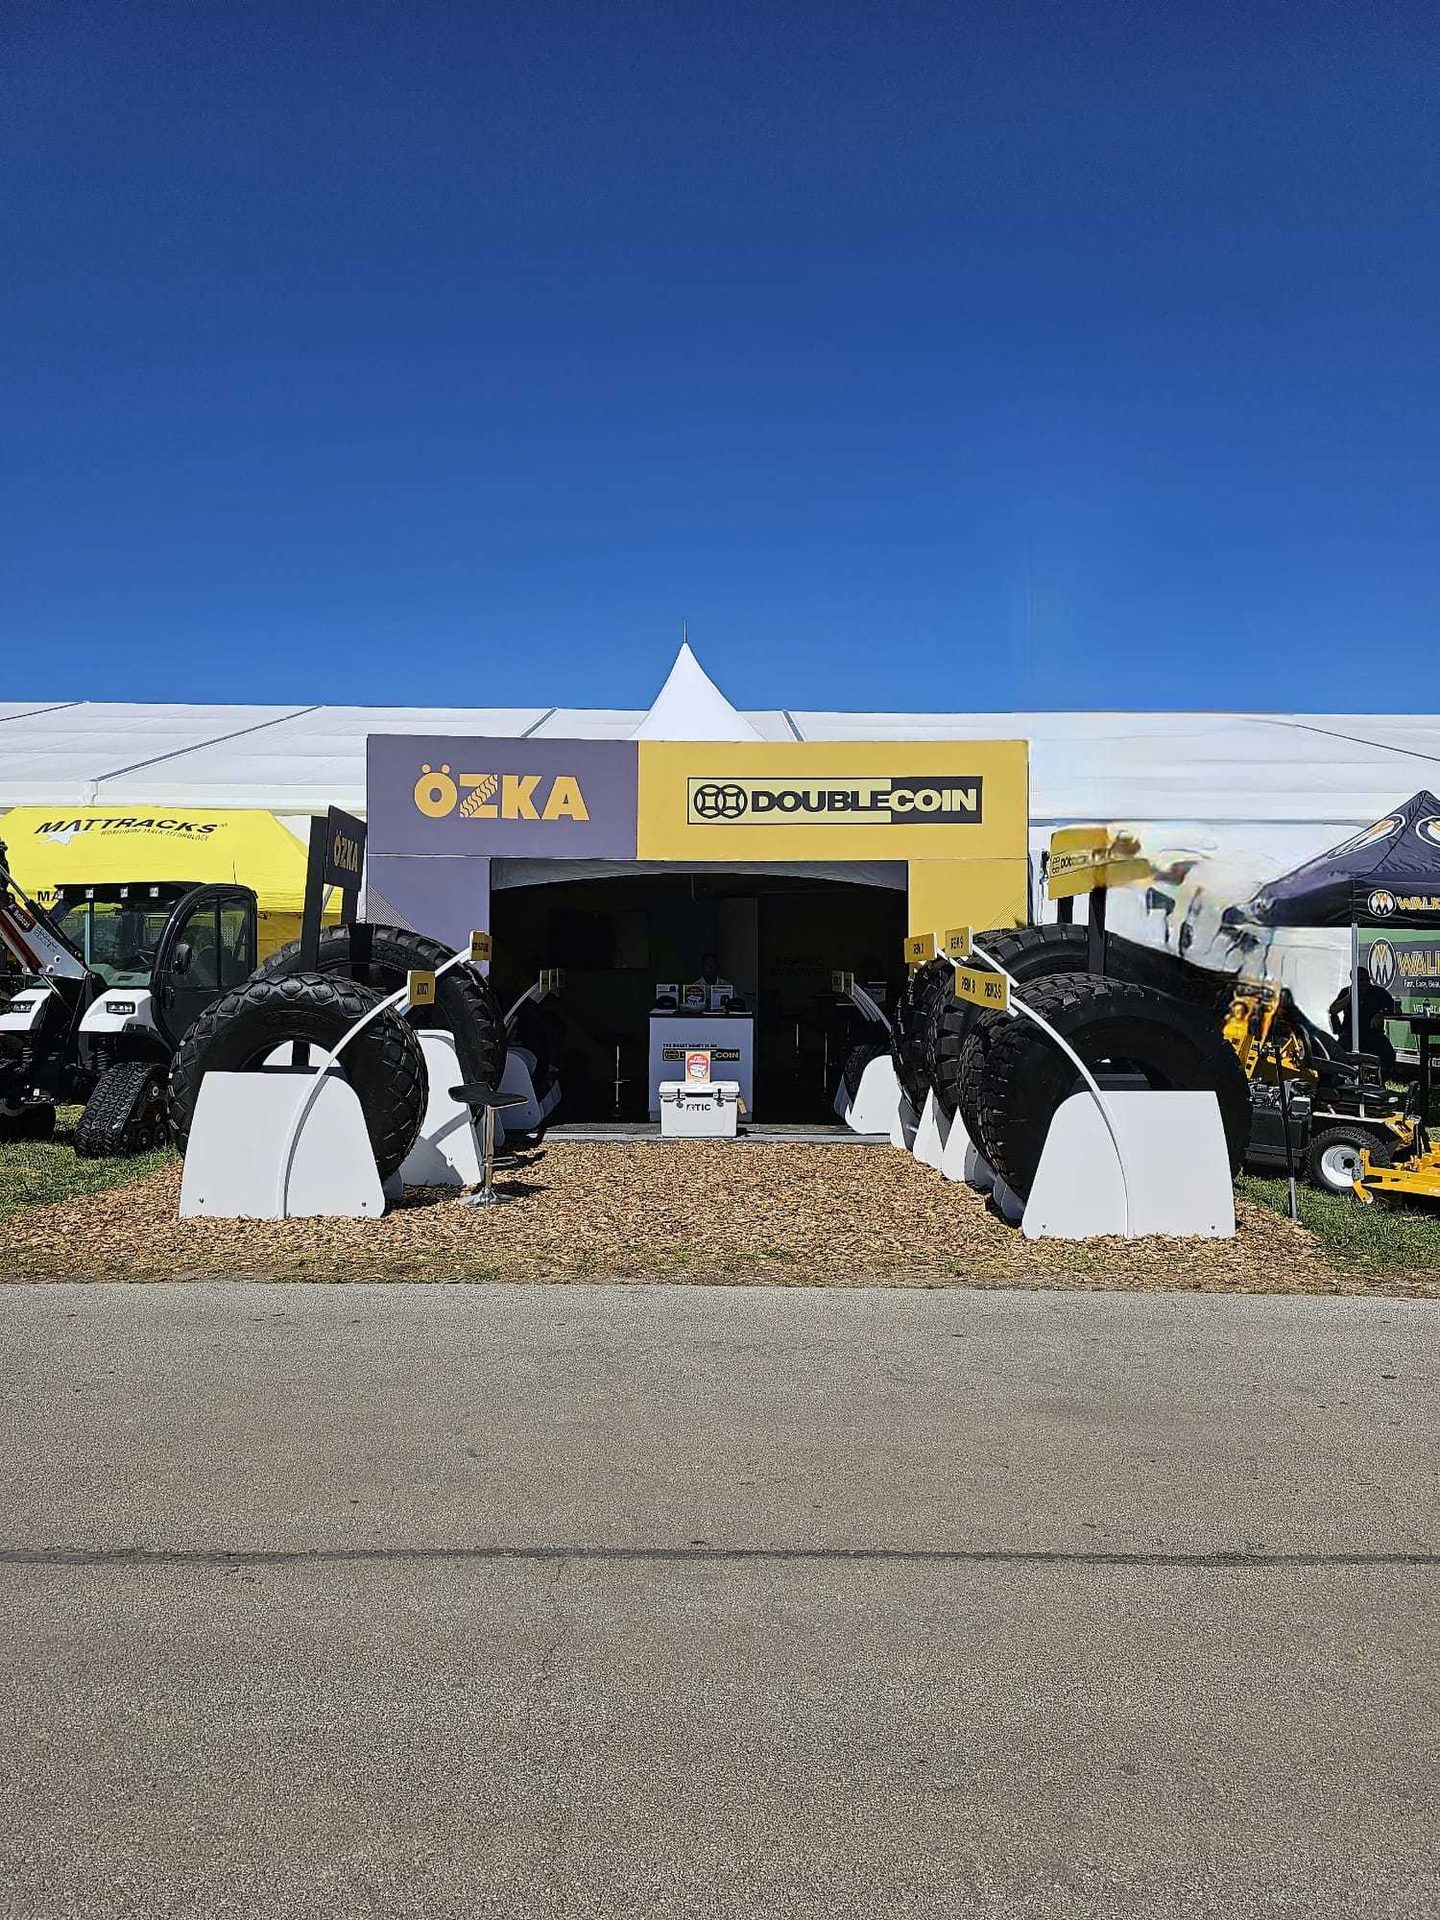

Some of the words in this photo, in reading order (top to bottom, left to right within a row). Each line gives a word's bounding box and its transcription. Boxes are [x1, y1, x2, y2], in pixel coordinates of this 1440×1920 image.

[414, 763, 590, 820] ÖZKA
[751, 788, 977, 812] DOUBLECOIN
[34, 818, 218, 834] MATTRACKS
[333, 829, 358, 873] ÖZKA
[686, 1103, 711, 1112] RTIC
